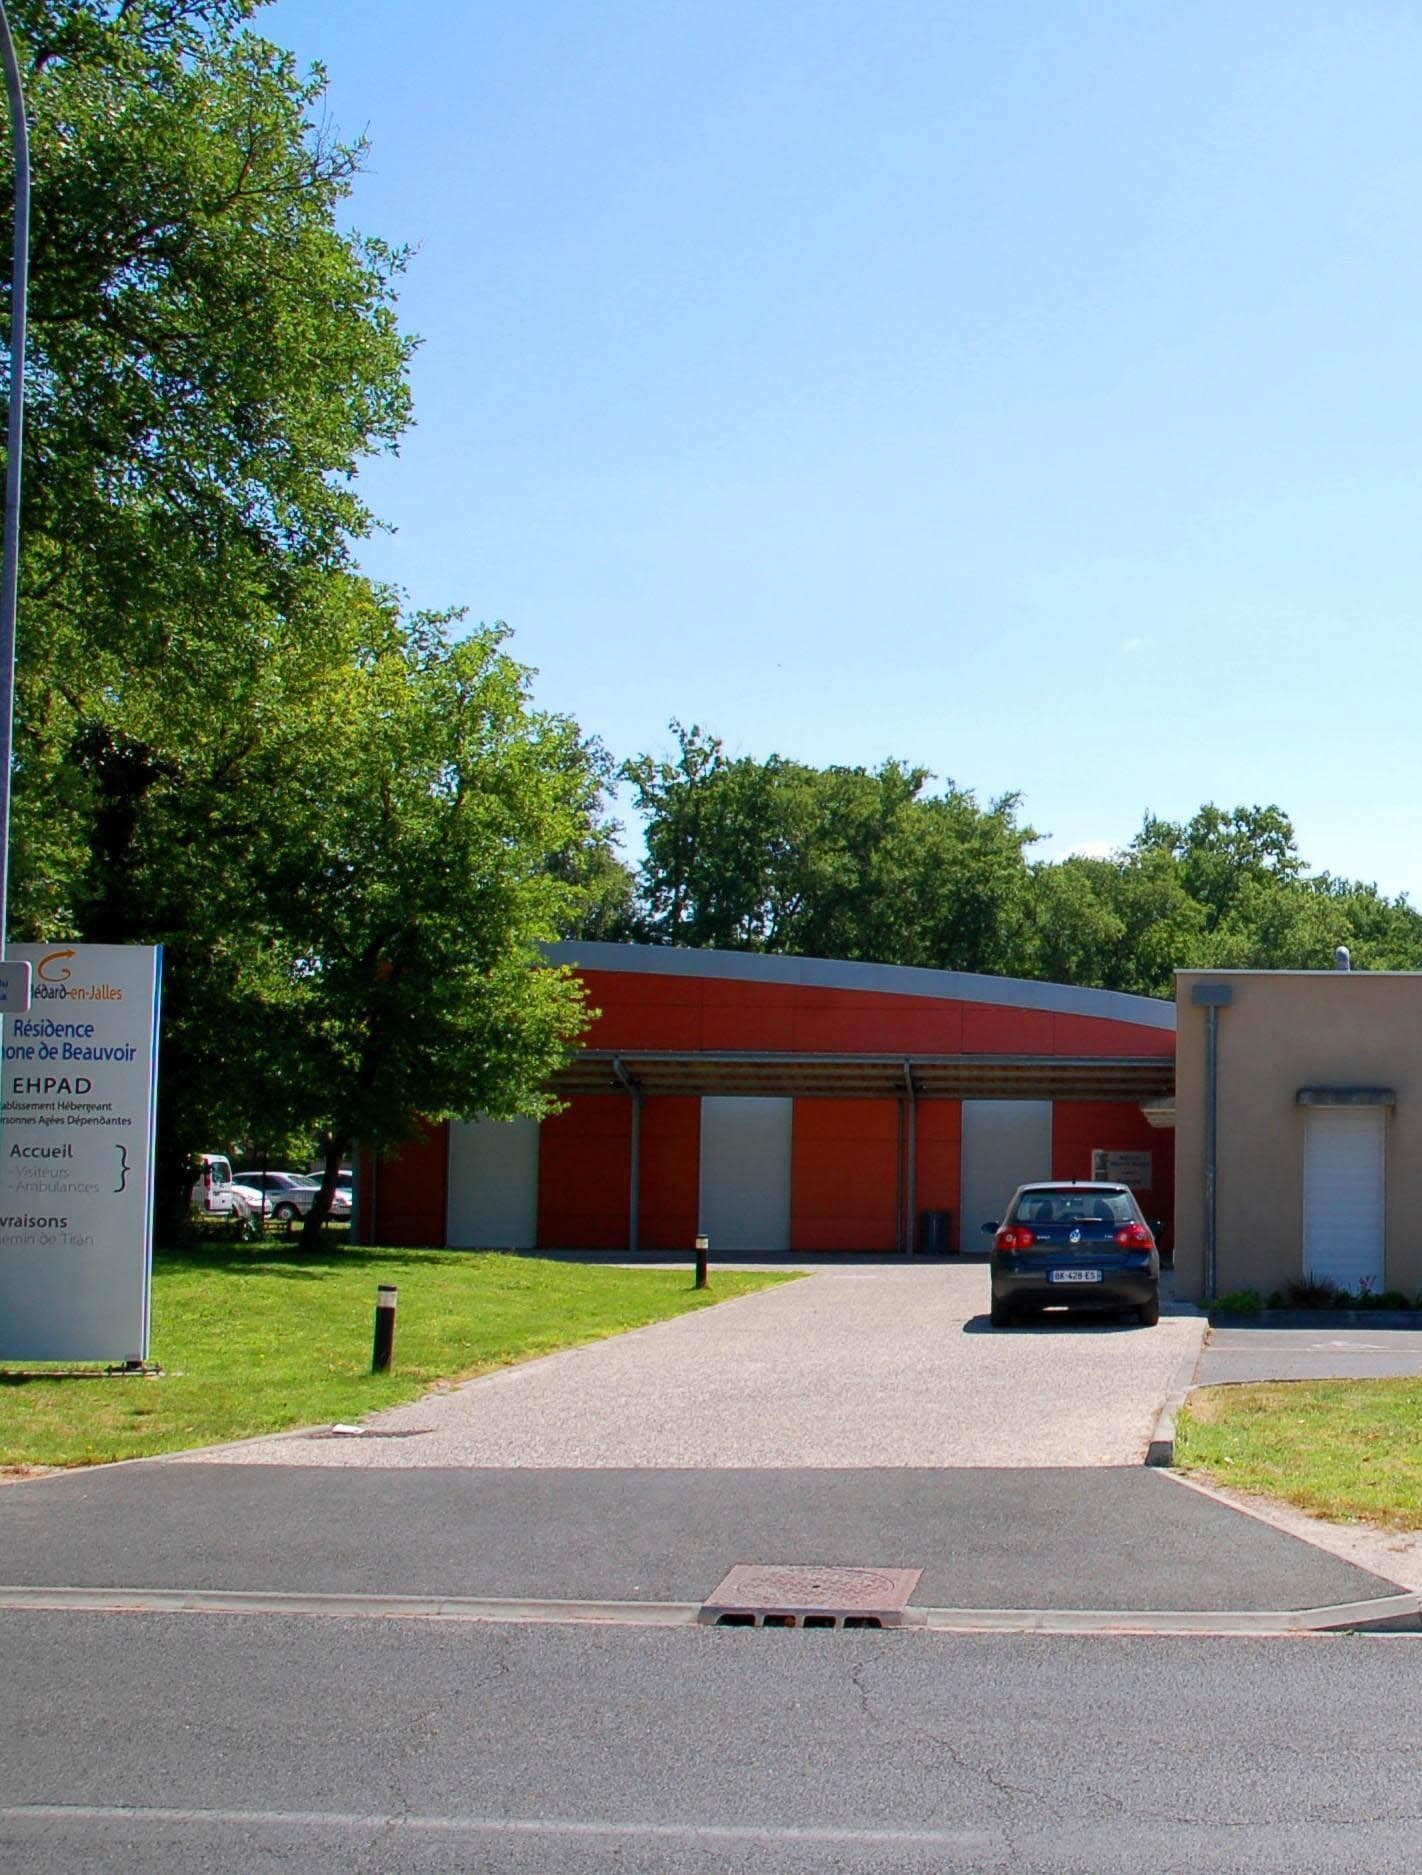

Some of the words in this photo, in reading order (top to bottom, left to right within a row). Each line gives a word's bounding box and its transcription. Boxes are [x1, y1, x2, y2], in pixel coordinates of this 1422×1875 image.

[31, 983, 122, 1000] édard-en-Jalles
[14, 1019, 94, 1038] Résidence
[39, 1042, 58, 1060] de
[62, 1042, 136, 1061] Beauvoir
[13, 1077, 92, 1094] EHPAD
[67, 1115, 132, 1127] Dépendantes
[10, 1144, 73, 1158] Accueil
[0, 1213, 68, 1228] vraisons
